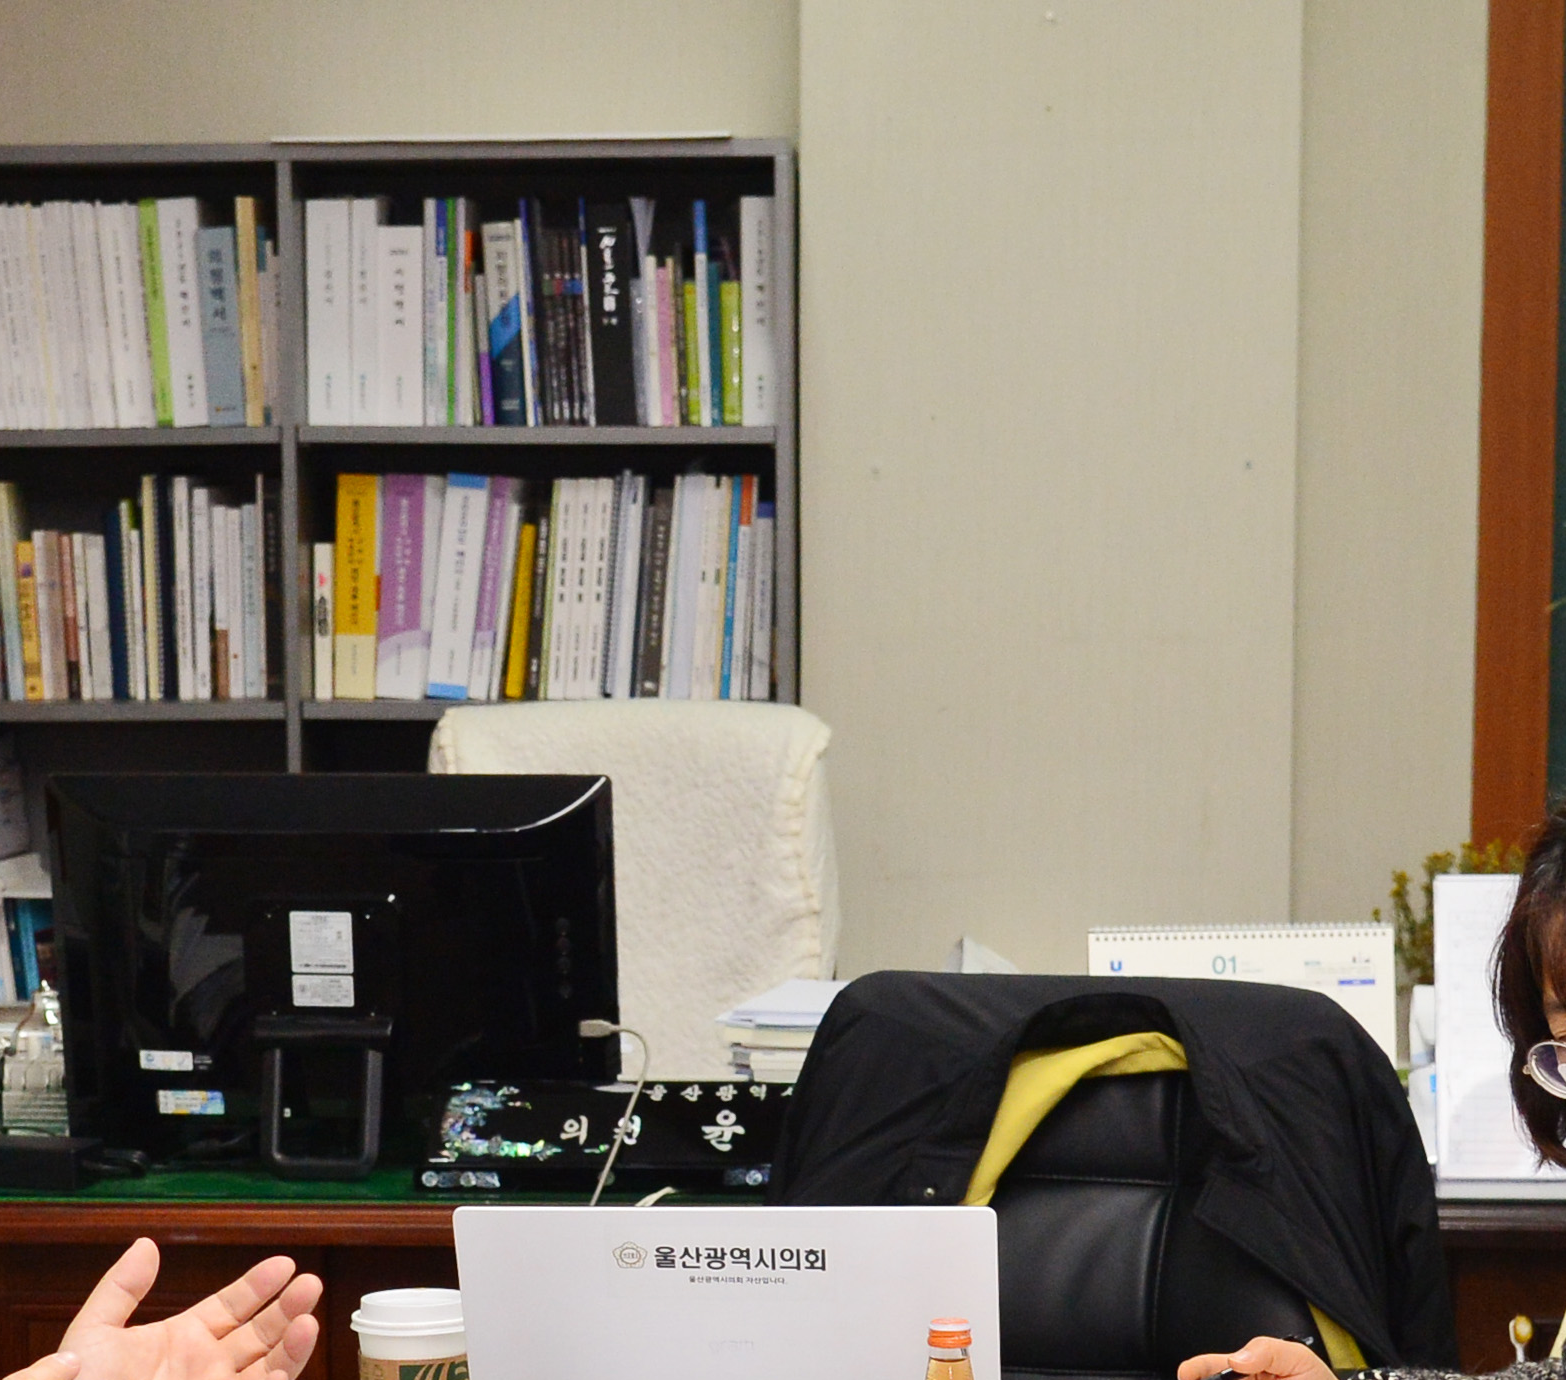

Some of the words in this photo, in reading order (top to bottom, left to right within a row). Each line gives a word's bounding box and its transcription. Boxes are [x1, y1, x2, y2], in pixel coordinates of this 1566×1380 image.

[1211, 955, 1238, 975] 01
[653, 1246, 827, 1271] 울산광역시의회
[689, 1275, 744, 1284] 울산광역시의회
[745, 1276, 788, 1285] 자산입니다.
